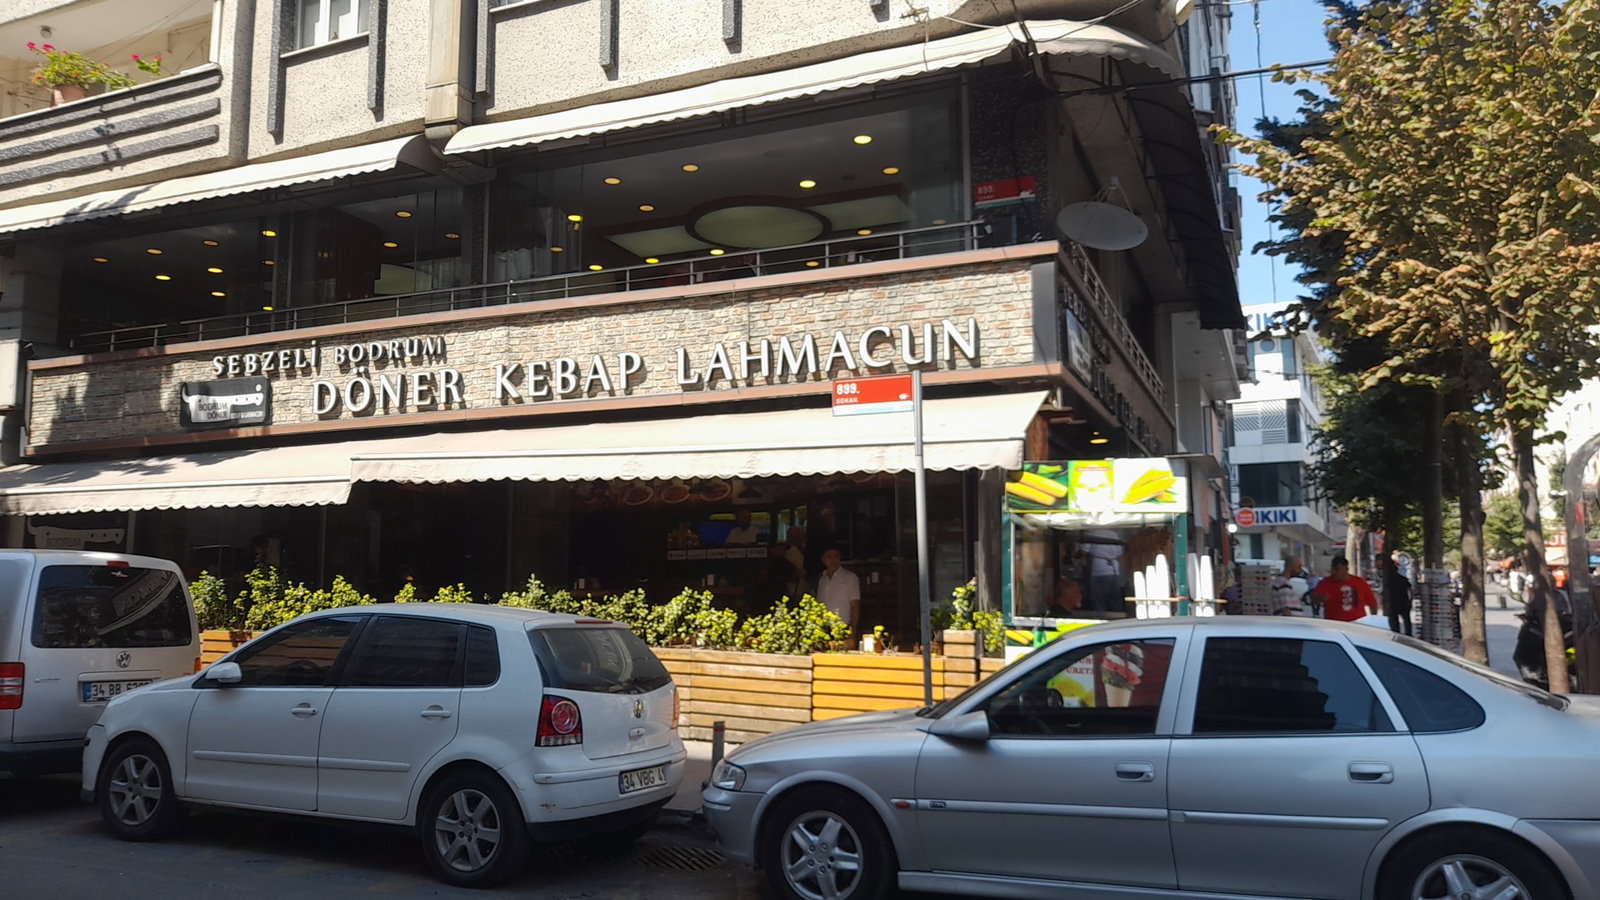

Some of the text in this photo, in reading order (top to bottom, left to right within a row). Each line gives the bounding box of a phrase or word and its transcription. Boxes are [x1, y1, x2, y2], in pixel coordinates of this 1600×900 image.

[212, 336, 444, 375] SEBZELİ BODRUM
[312, 317, 977, 415] DÖNER KEBAP LAHMACUN
[836, 382, 860, 395] 899.
[198, 402, 229, 412] BODRUM
[92, 684, 105, 697] 34
[108, 683, 122, 695] BB
[623, 773, 636, 790] 34
